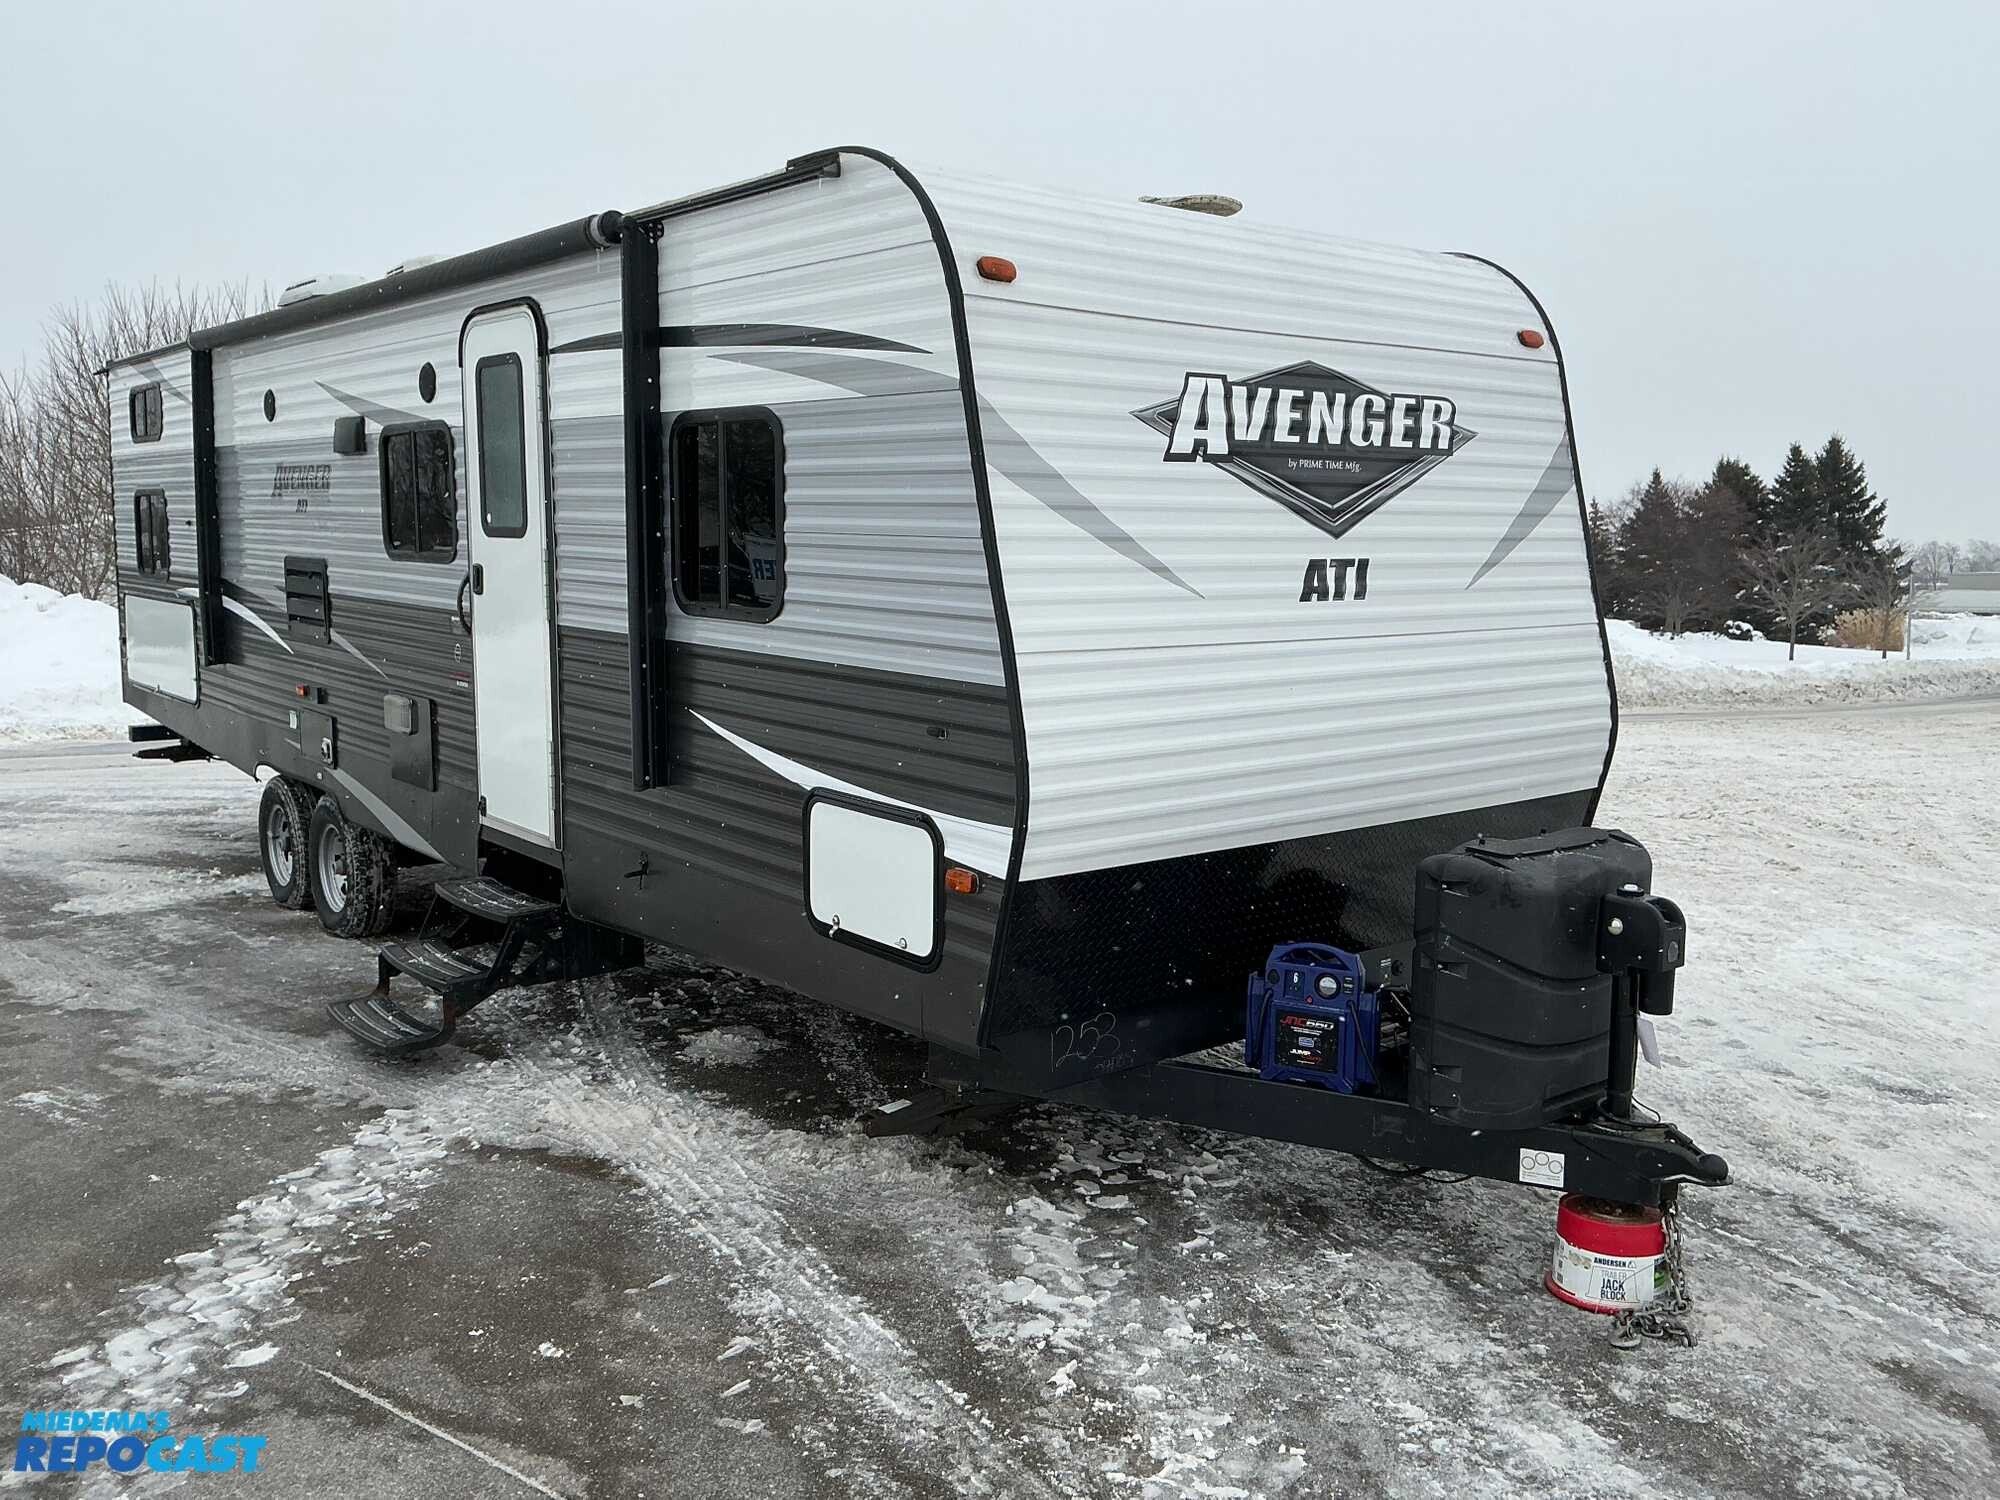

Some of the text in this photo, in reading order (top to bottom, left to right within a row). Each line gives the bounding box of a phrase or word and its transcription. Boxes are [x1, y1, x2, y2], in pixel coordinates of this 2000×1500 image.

[1164, 372, 1456, 462] AVENGER
[1288, 458, 1298, 471] by
[1299, 459, 1324, 469] PRIME
[1325, 460, 1343, 470] TIME
[271, 464, 331, 497] AVENGER
[1298, 558, 1370, 603] ATI
[1593, 1256, 1627, 1268] ANDERSEN
[1600, 1269, 1627, 1280] TRAILER
[1601, 1278, 1625, 1291] JACK
[1600, 1289, 1626, 1301] BLOCK
